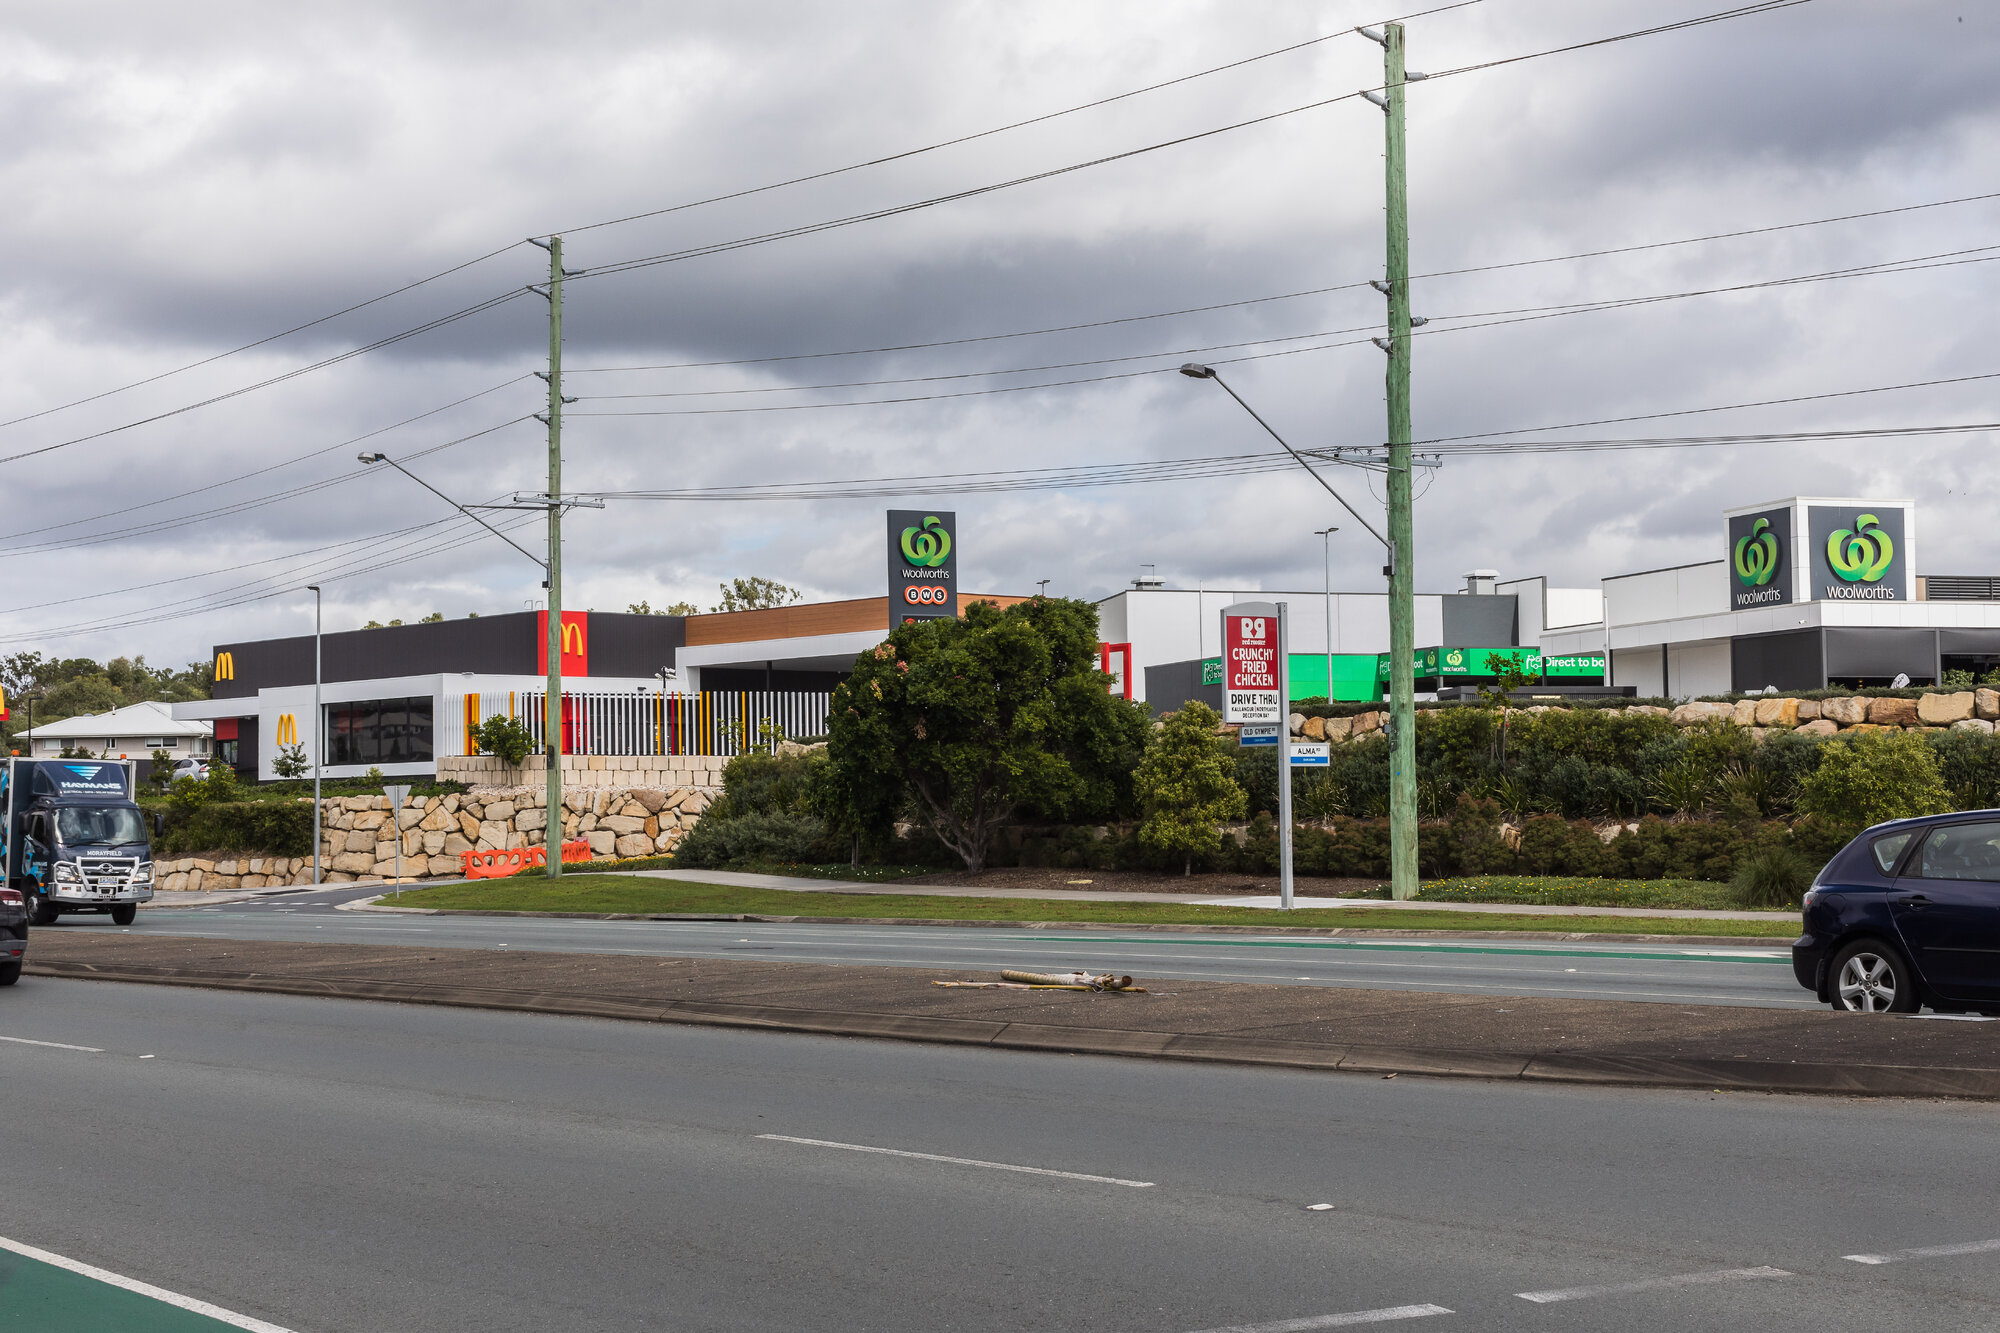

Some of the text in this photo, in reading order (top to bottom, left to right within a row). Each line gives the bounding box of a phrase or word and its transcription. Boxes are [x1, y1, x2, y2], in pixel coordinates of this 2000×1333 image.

[902, 568, 950, 579] Woolworths
[1736, 587, 1781, 605] Woolworths
[1826, 584, 1895, 600] Woolworths
[1232, 648, 1274, 661] CRUNCHY
[1242, 661, 1267, 673] FRIED
[1545, 657, 1605, 667] Direct to bo
[1235, 673, 1274, 686] CHICKEN
[1231, 694, 1278, 704] DRIVE THRU
[61, 781, 122, 790] HAYMANS
